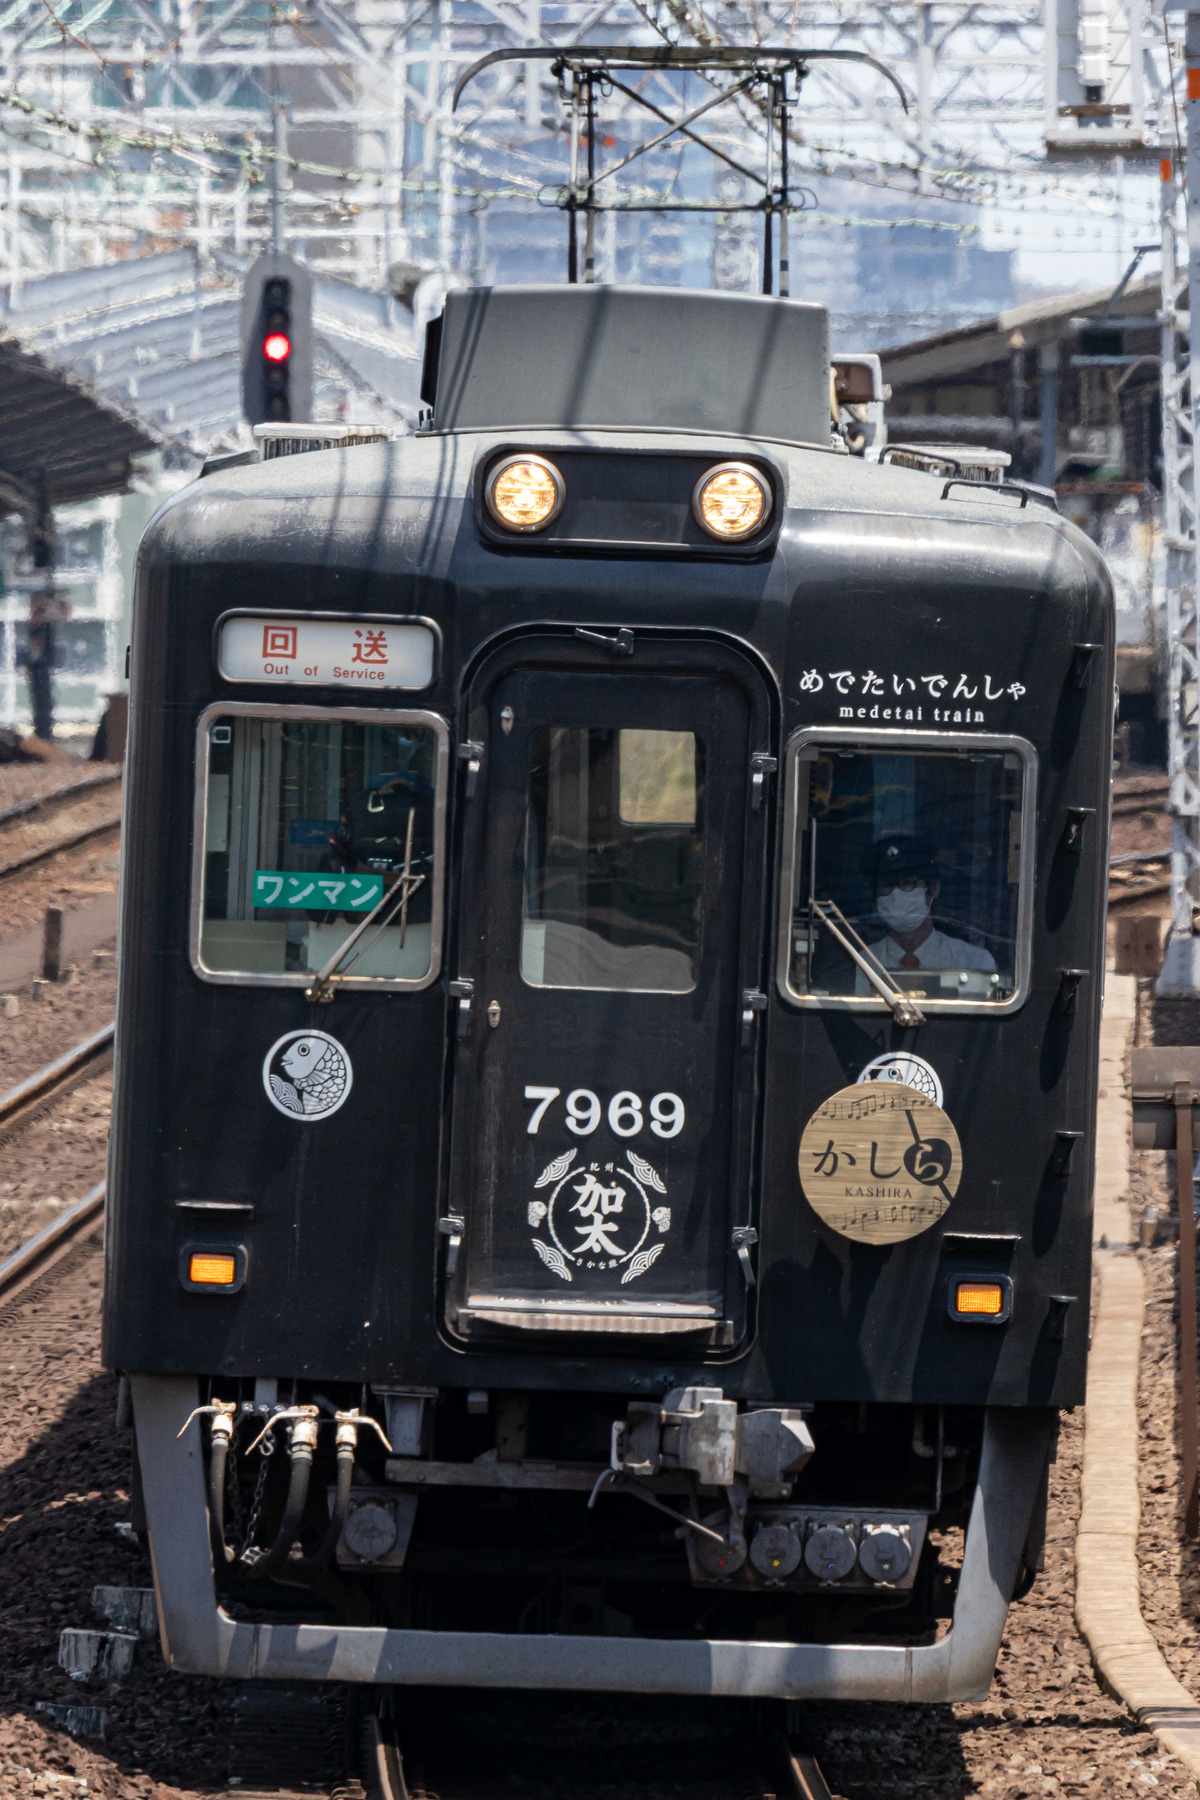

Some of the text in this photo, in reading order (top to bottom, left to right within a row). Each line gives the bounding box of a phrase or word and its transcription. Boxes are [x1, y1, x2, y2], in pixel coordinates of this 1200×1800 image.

[262, 625, 389, 664] 回送
[264, 663, 385, 680] Out of Service
[800, 669, 1026, 700] めでたいでんしゃ
[839, 705, 985, 722] medetai train
[257, 876, 379, 907] ワンマン
[524, 1085, 685, 1138] 7969
[812, 1139, 945, 1182] かしら
[845, 1187, 912, 1199] KASHIRA
[569, 1174, 627, 1256] 加太
